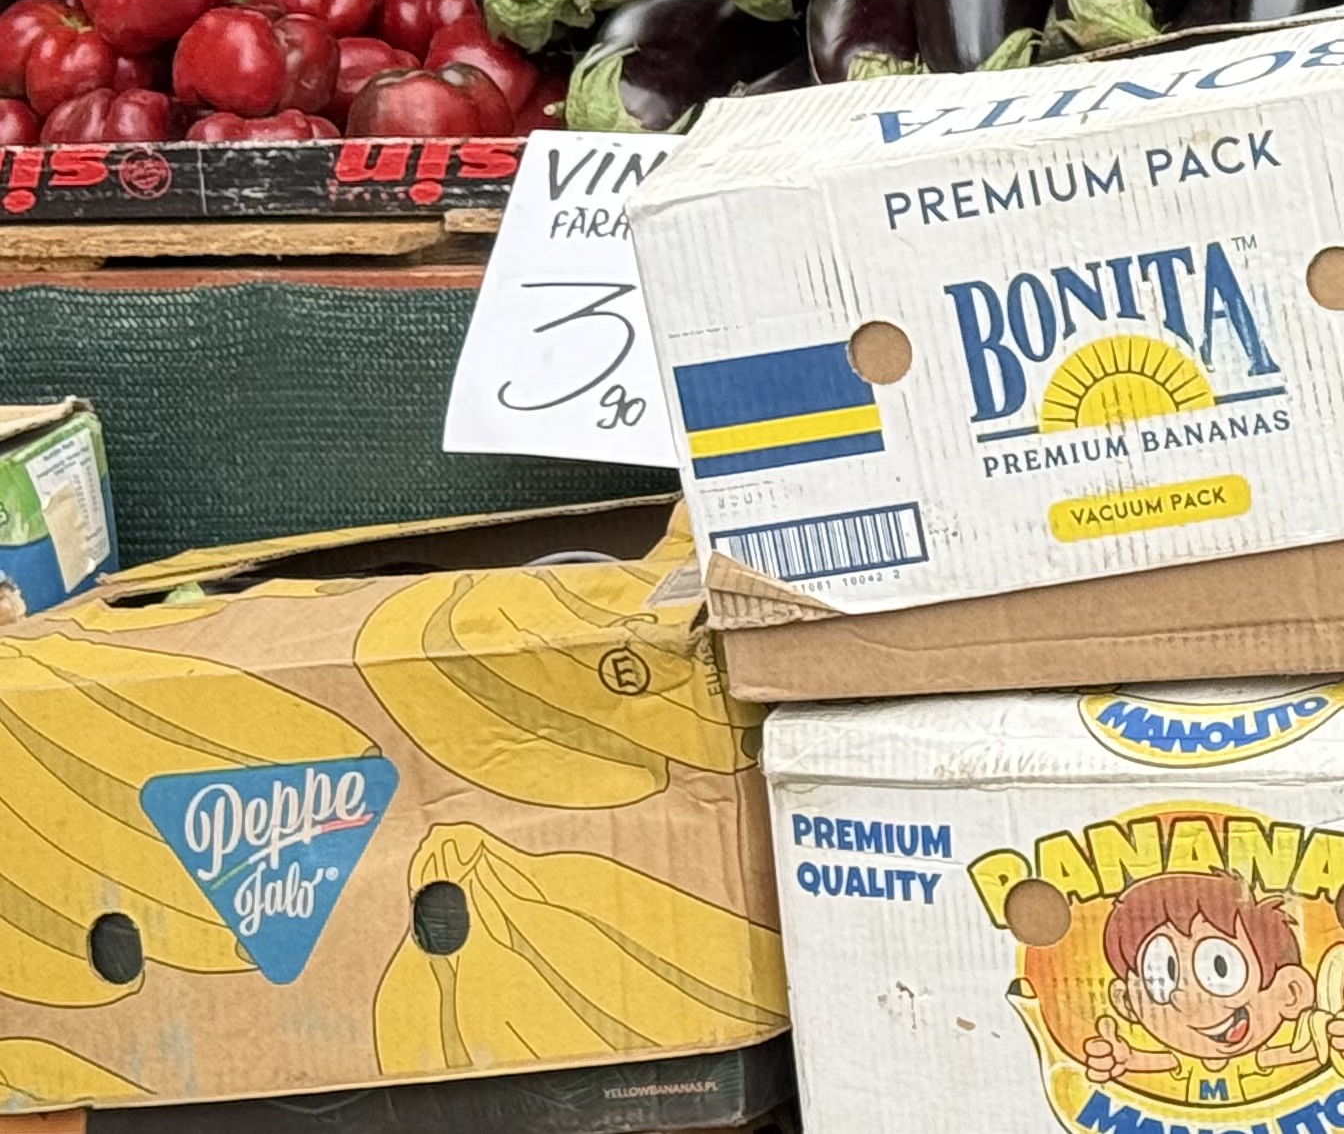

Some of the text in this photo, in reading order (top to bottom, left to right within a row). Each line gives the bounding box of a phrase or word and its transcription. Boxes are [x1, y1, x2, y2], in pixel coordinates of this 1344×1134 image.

[884, 129, 1282, 231] PREMIUM PACK
[499, 281, 638, 412] 3
[943, 240, 1281, 423] BONITA
[596, 383, 648, 430] 90
[981, 408, 1292, 479] PREMIUM BANANAS
[1068, 485, 1227, 529] VACUUM PACK
[1097, 692, 1332, 754] MANOLITO
[184, 767, 367, 882] Peppe
[791, 812, 953, 860] PREMIUM
[795, 861, 941, 906] QUALITY
[603, 1081, 720, 1100] YELLOWBANANAS.PL
